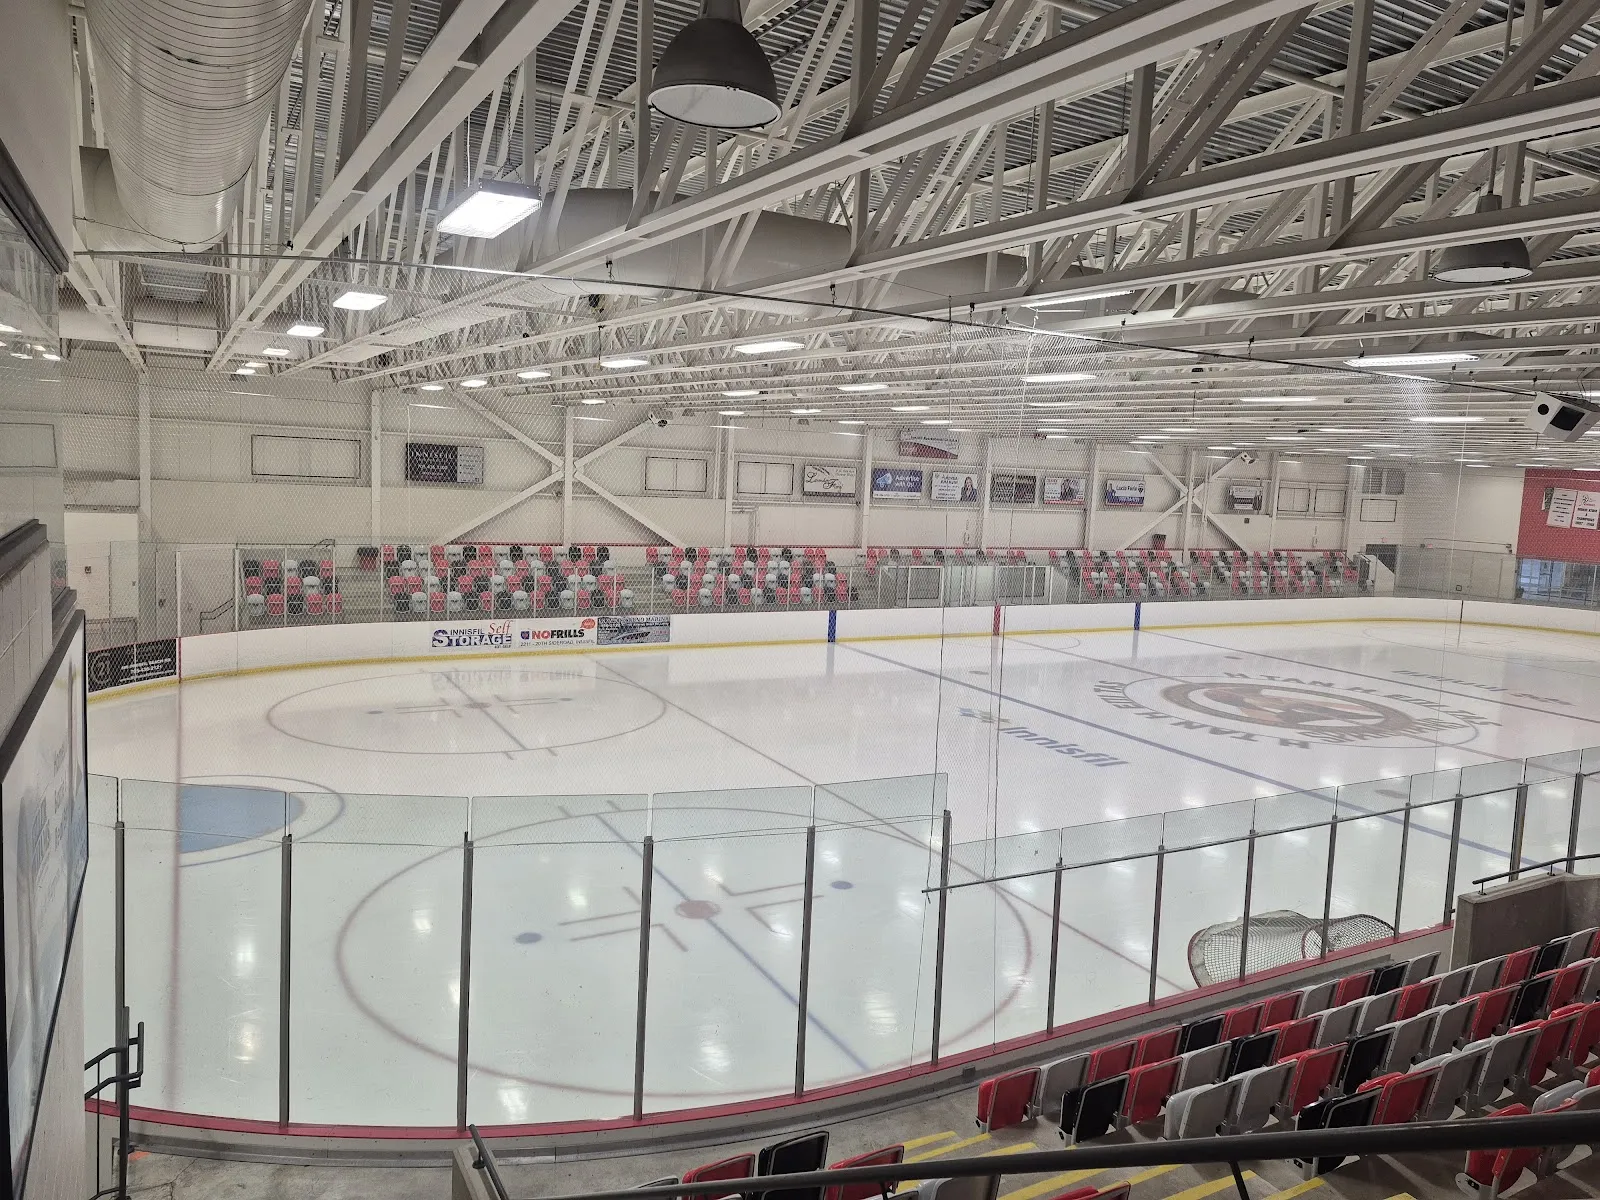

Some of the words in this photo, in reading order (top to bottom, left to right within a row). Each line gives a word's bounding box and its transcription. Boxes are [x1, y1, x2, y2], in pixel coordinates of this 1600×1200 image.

[488, 620, 513, 635] Self
[432, 629, 512, 647] STORAGE
[997, 726, 1129, 767] Innisfil
